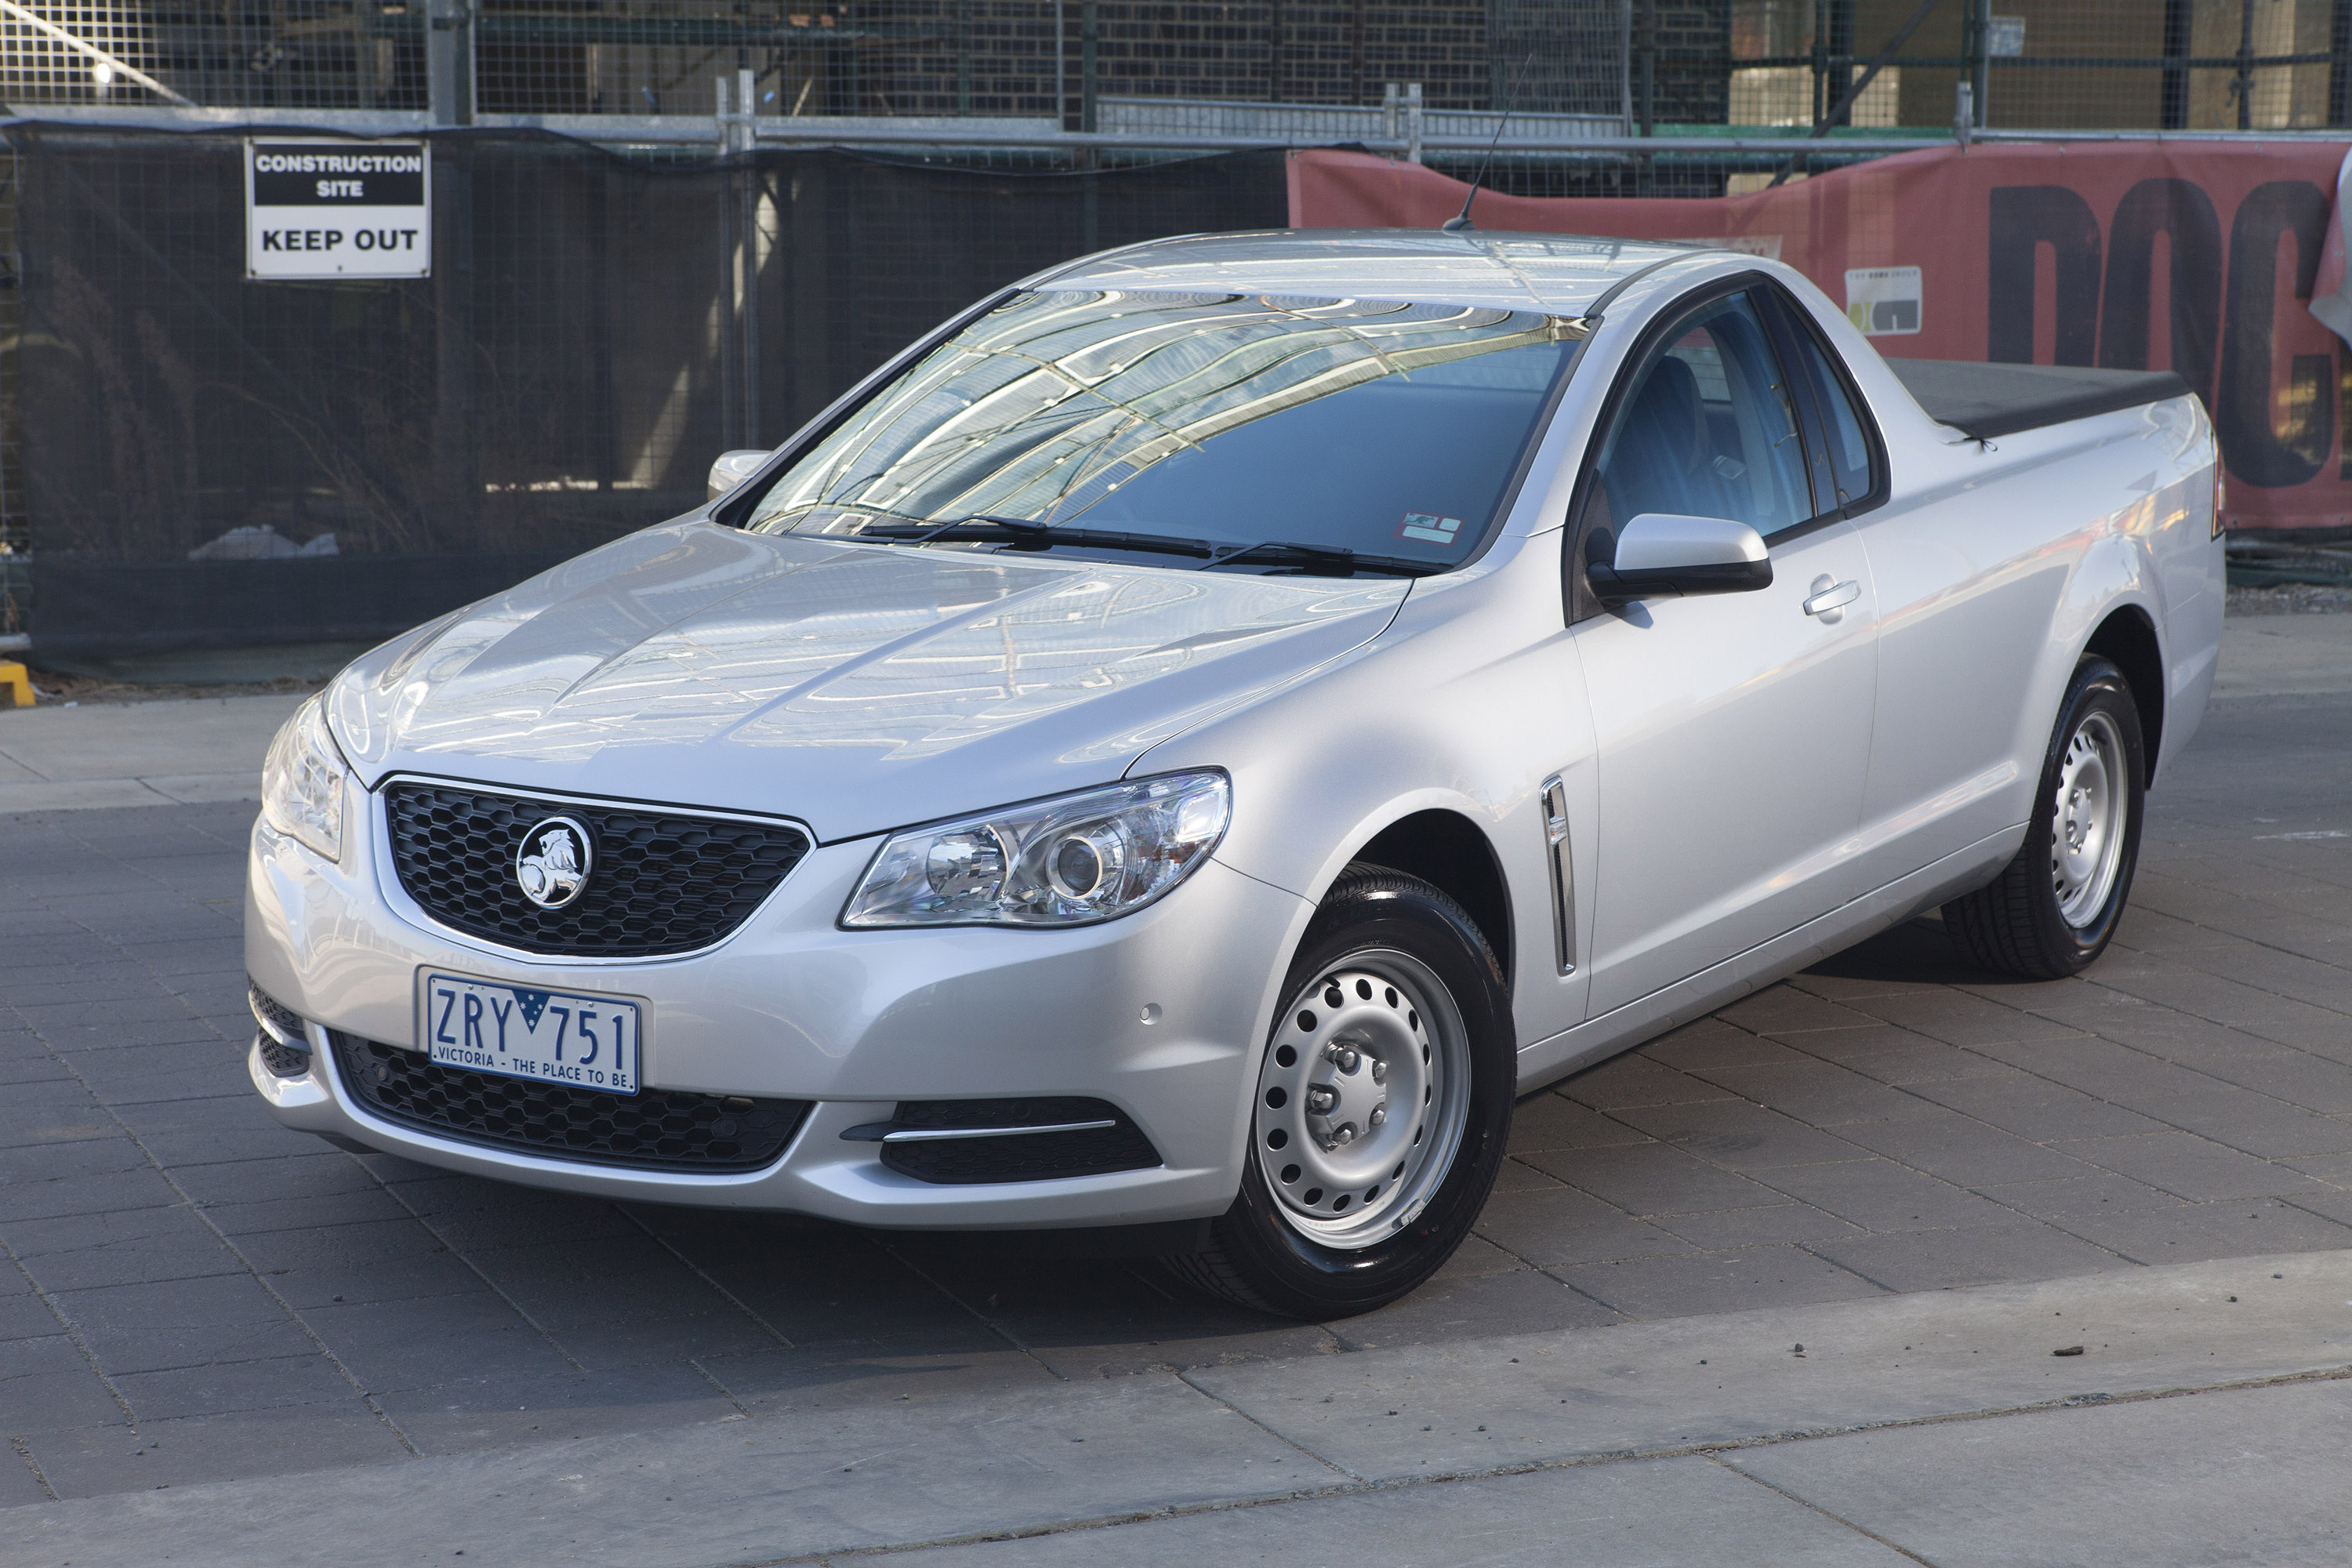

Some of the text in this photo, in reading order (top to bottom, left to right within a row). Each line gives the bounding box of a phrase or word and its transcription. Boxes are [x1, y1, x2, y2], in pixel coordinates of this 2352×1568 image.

[256, 155, 422, 172] CONSTRUCTION
[317, 180, 363, 197] SITE
[263, 230, 418, 251] KEEP OUT
[437, 988, 622, 1070] ZRY 751
[438, 1046, 494, 1067] VICTORIA
[513, 1058, 535, 1073] THE
[543, 1062, 580, 1080] PLACE
[588, 1069, 604, 1083] TO
[612, 1073, 626, 1087] BE
